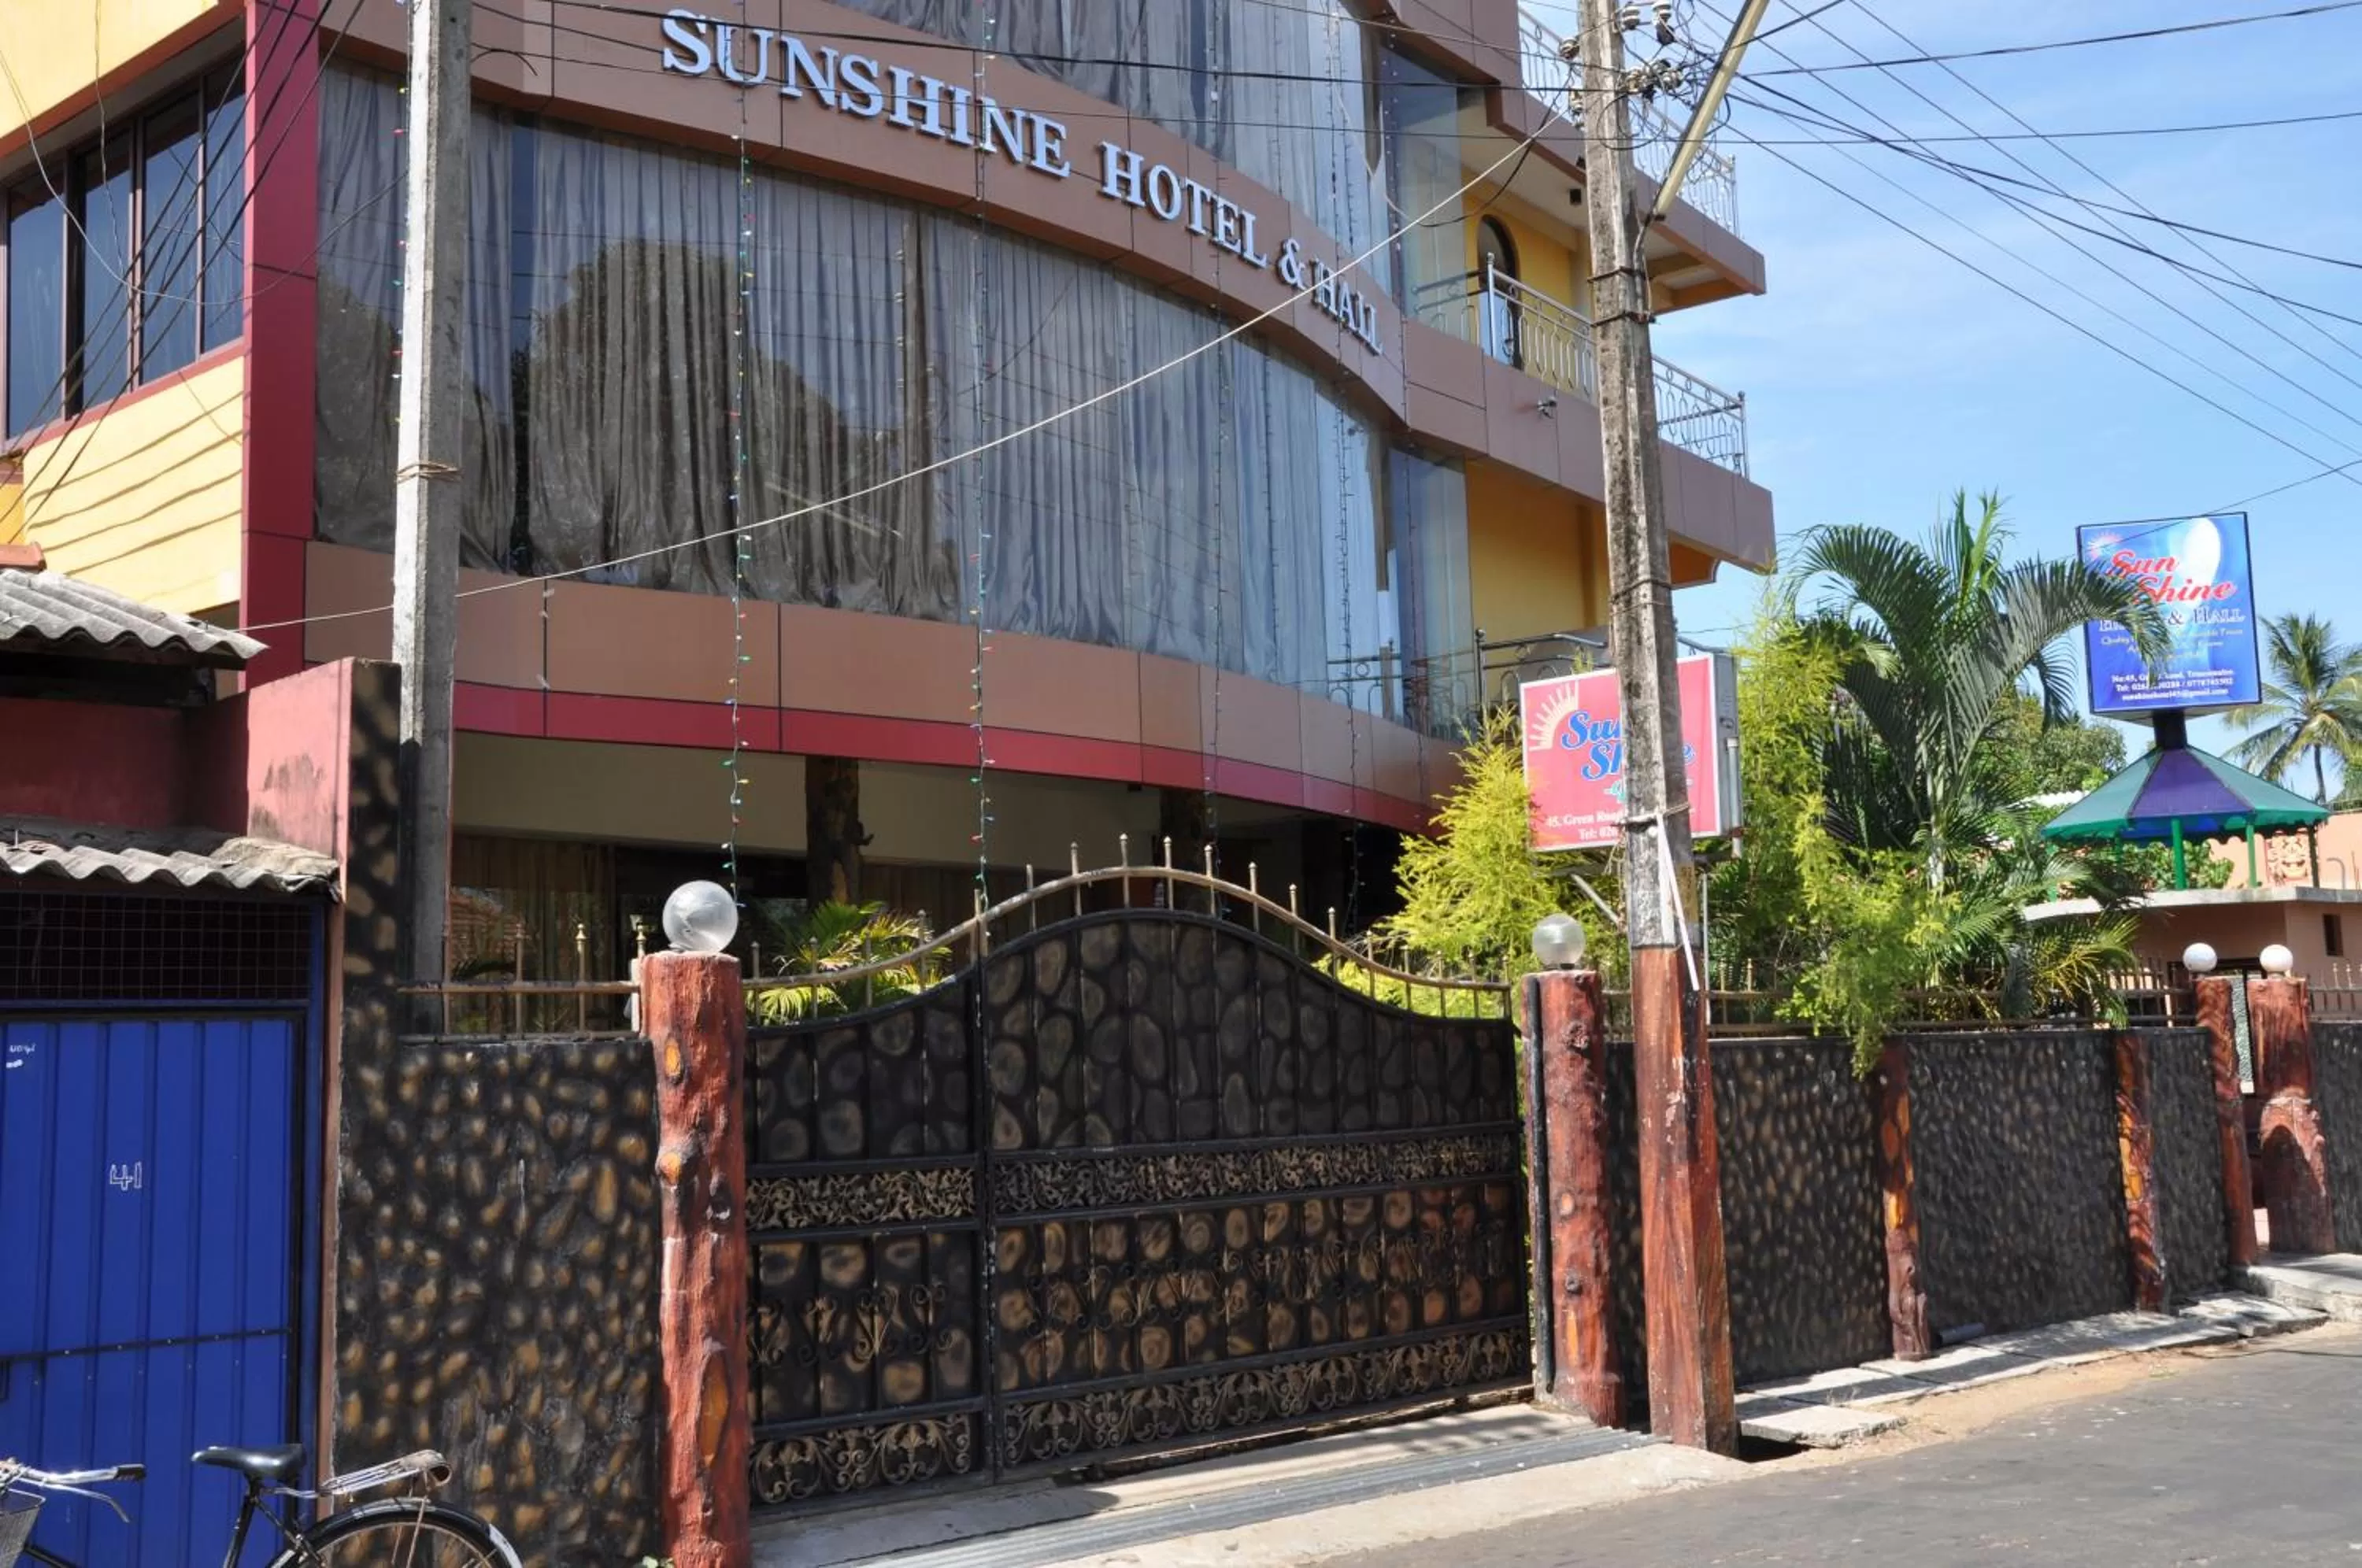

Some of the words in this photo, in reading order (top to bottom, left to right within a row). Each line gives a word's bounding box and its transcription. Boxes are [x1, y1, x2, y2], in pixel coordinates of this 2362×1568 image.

[661, 8, 1071, 178] SUNSHINE
[1100, 140, 1267, 268] HOTEL
[1275, 238, 1307, 290] &
[1311, 255, 1383, 355] HALL
[2106, 550, 2179, 579] Sun
[2133, 575, 2237, 605] Shine
[109, 1161, 143, 1191] 41
